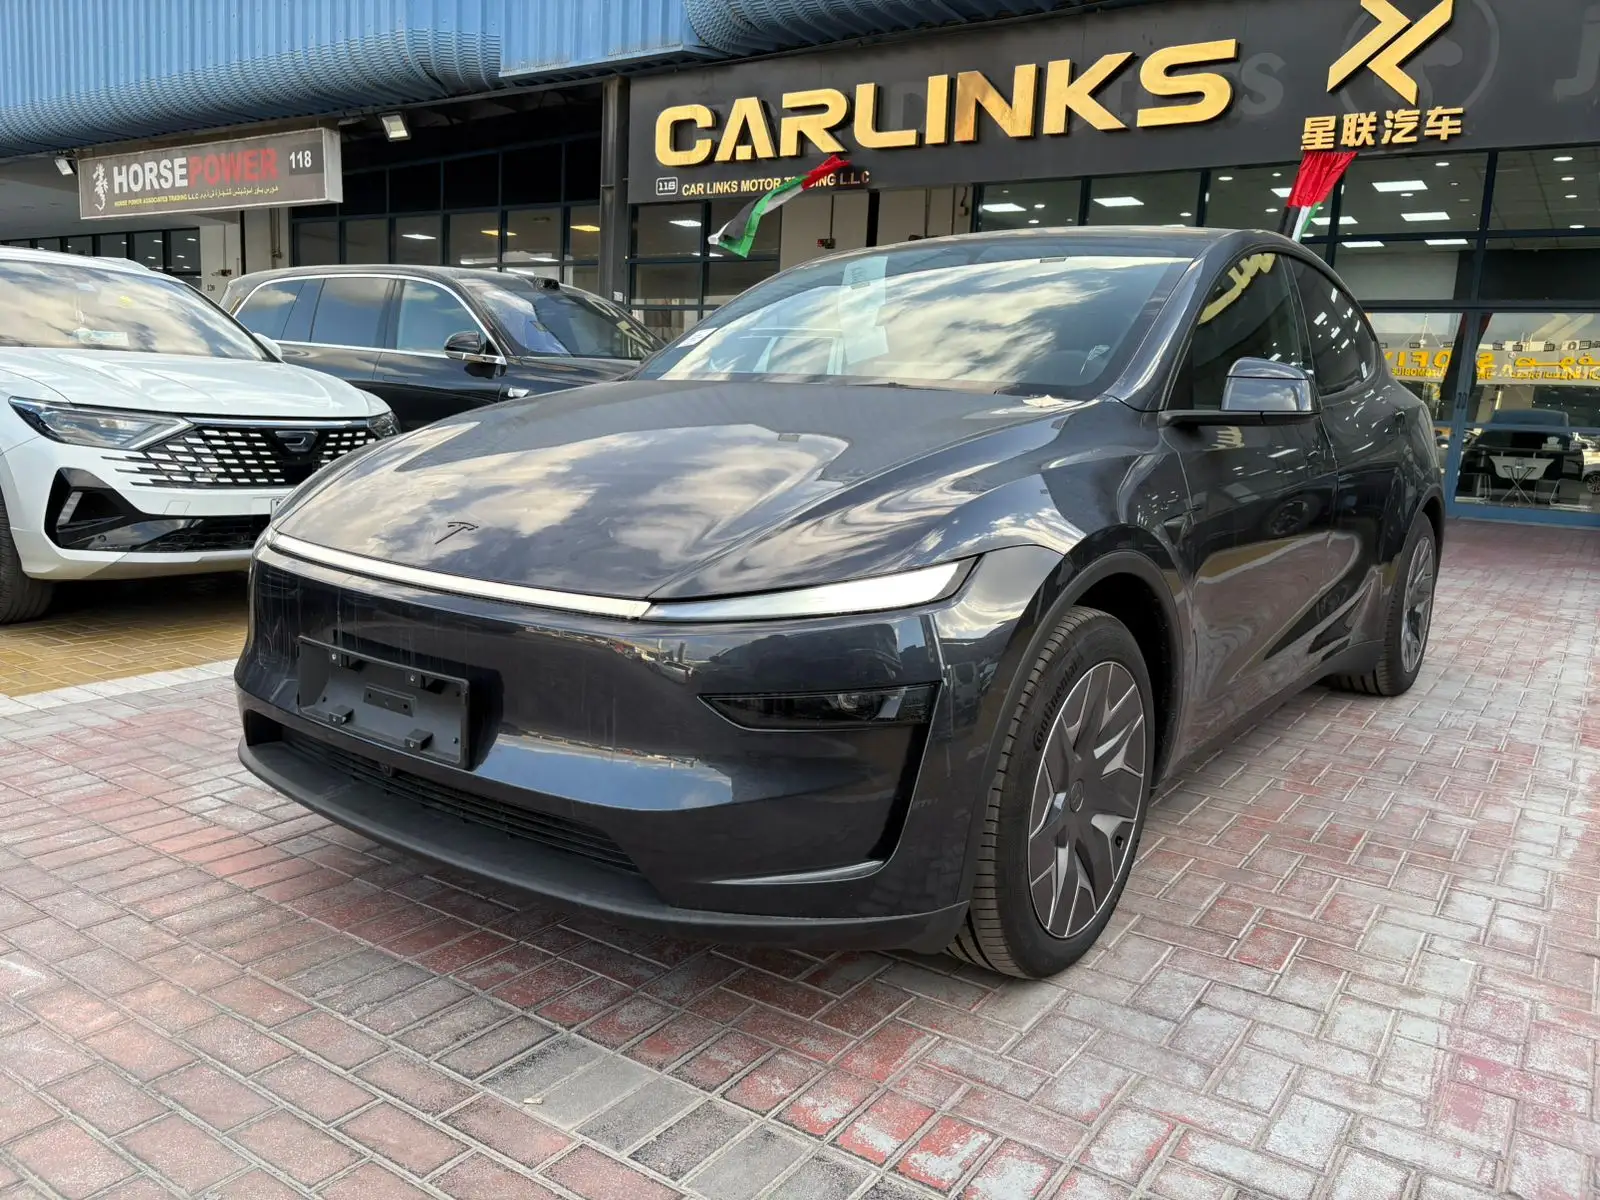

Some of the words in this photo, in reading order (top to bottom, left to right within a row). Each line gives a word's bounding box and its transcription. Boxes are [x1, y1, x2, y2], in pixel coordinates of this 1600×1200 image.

[1301, 106, 1463, 150] 星联汽车
[289, 150, 312, 169] 118
[682, 184, 704, 196] CAR
[706, 181, 738, 194] LINKS
[741, 178, 781, 192] MOTOR
